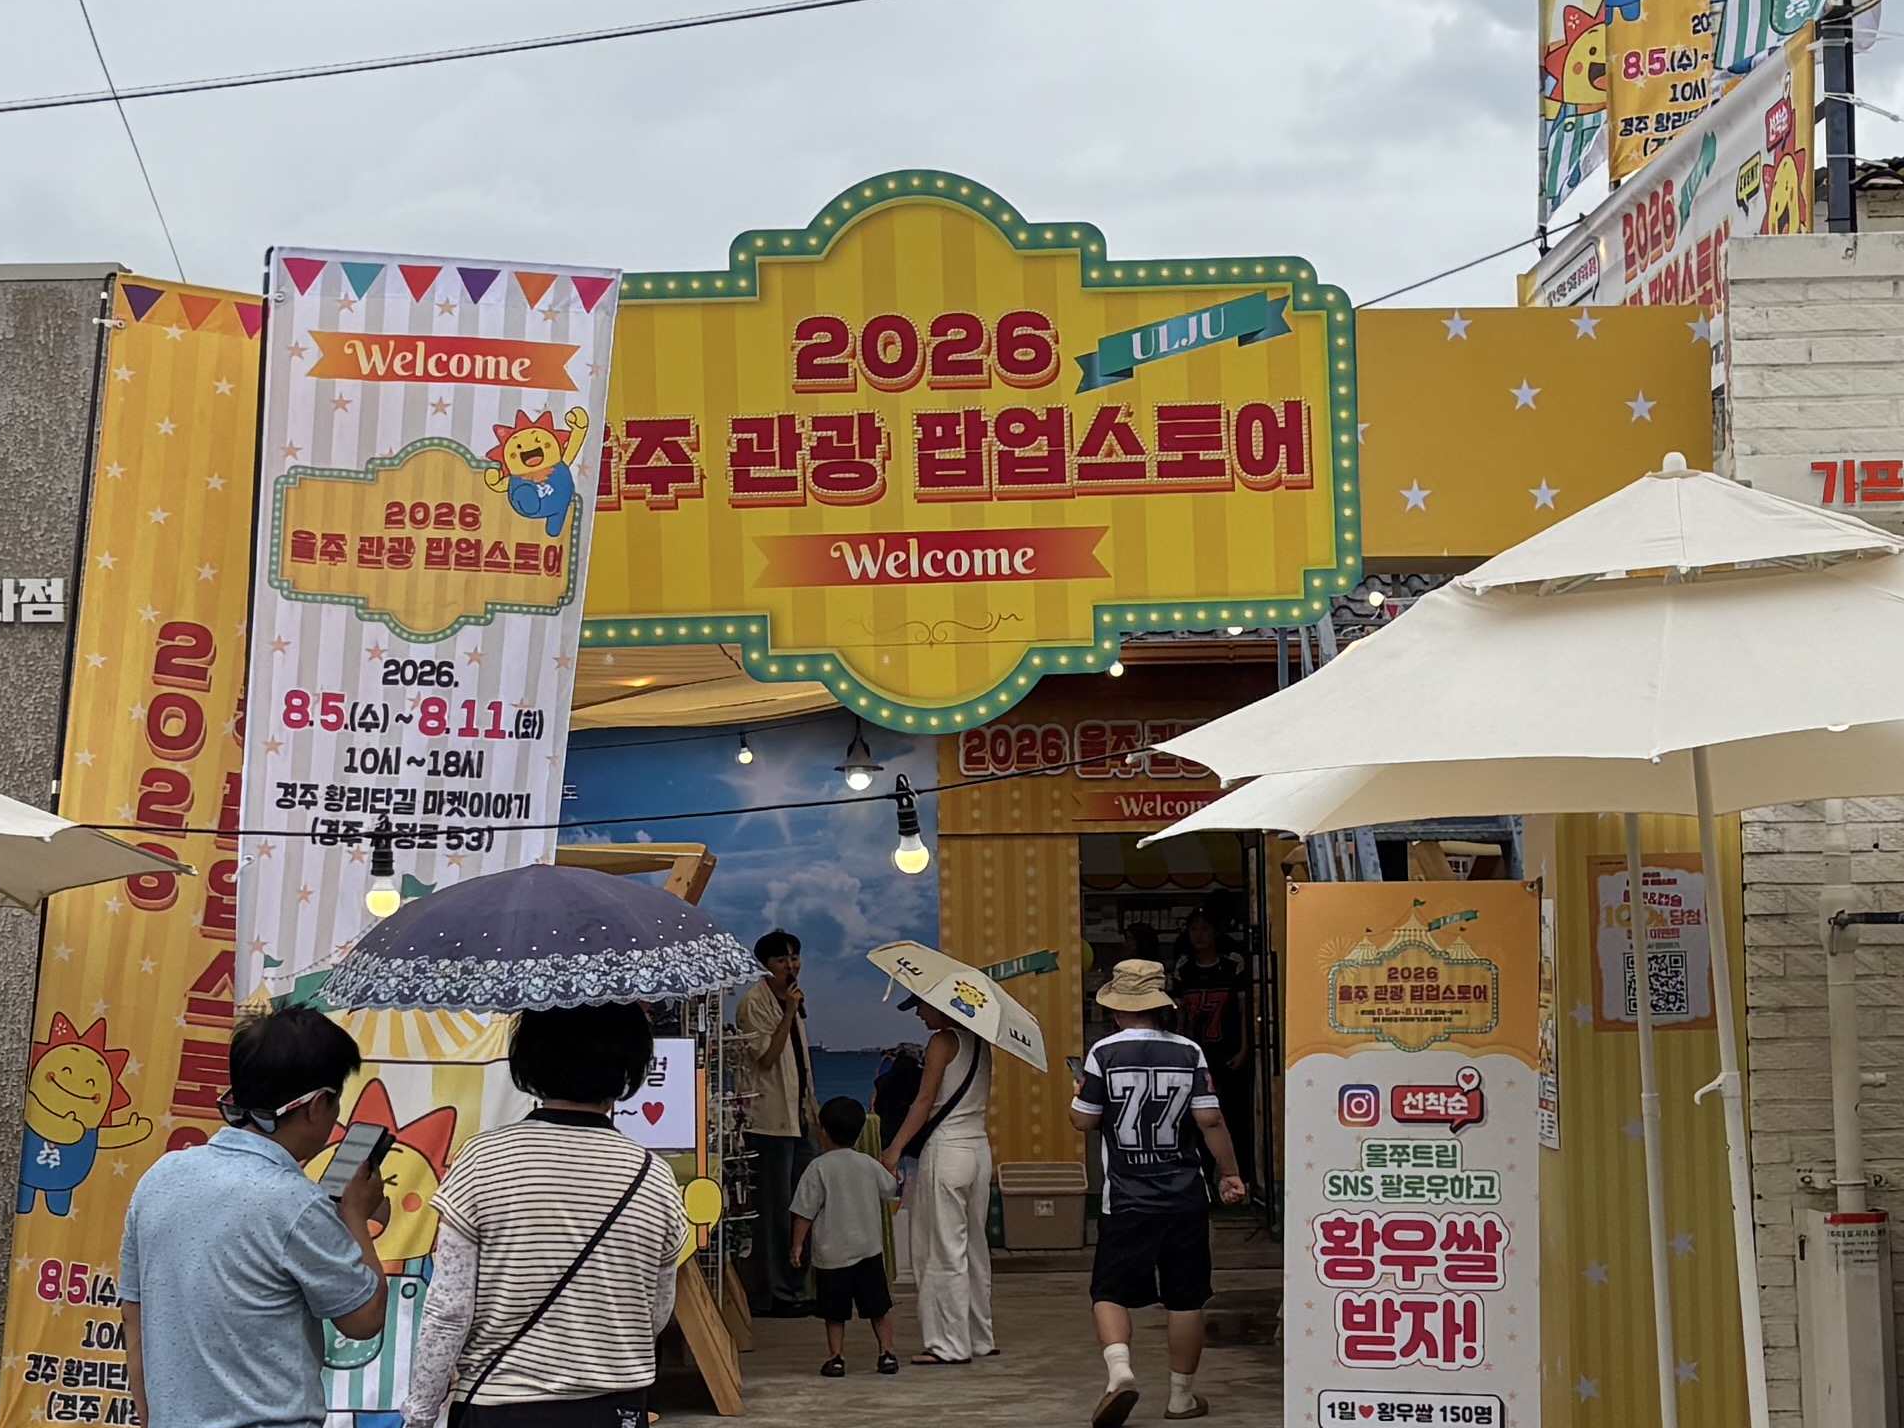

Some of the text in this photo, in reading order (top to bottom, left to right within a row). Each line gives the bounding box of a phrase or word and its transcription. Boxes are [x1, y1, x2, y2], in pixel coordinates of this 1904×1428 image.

[1622, 178, 1677, 284] 2026
[791, 309, 1061, 394] 2026
[1130, 305, 1229, 363] ULJU
[343, 338, 533, 384] Welcome
[598, 396, 1314, 511] 주 관광 팝업스토어
[384, 500, 483, 533] 2026
[290, 529, 564, 579] 울주 관광 팝업스토어
[829, 539, 1037, 580] Welcome
[381, 658, 459, 689] 2026.
[343, 746, 401, 776] 10시
[961, 725, 1067, 774] 2026
[275, 782, 532, 820] 경주 황리단길 마켓이야기
[1387, 966, 1439, 983] 2026
[1106, 1066, 1197, 1151] 77
[1402, 1091, 1470, 1116] 선착순
[1328, 1173, 1497, 1201] SNS 팔로우하고
[1319, 1216, 1503, 1284] 황우쌀
[1341, 1297, 1478, 1364] 받자!
[24, 1353, 60, 1384] 경주
[1326, 1400, 1494, 1425] 1일 황우쌀 150명
